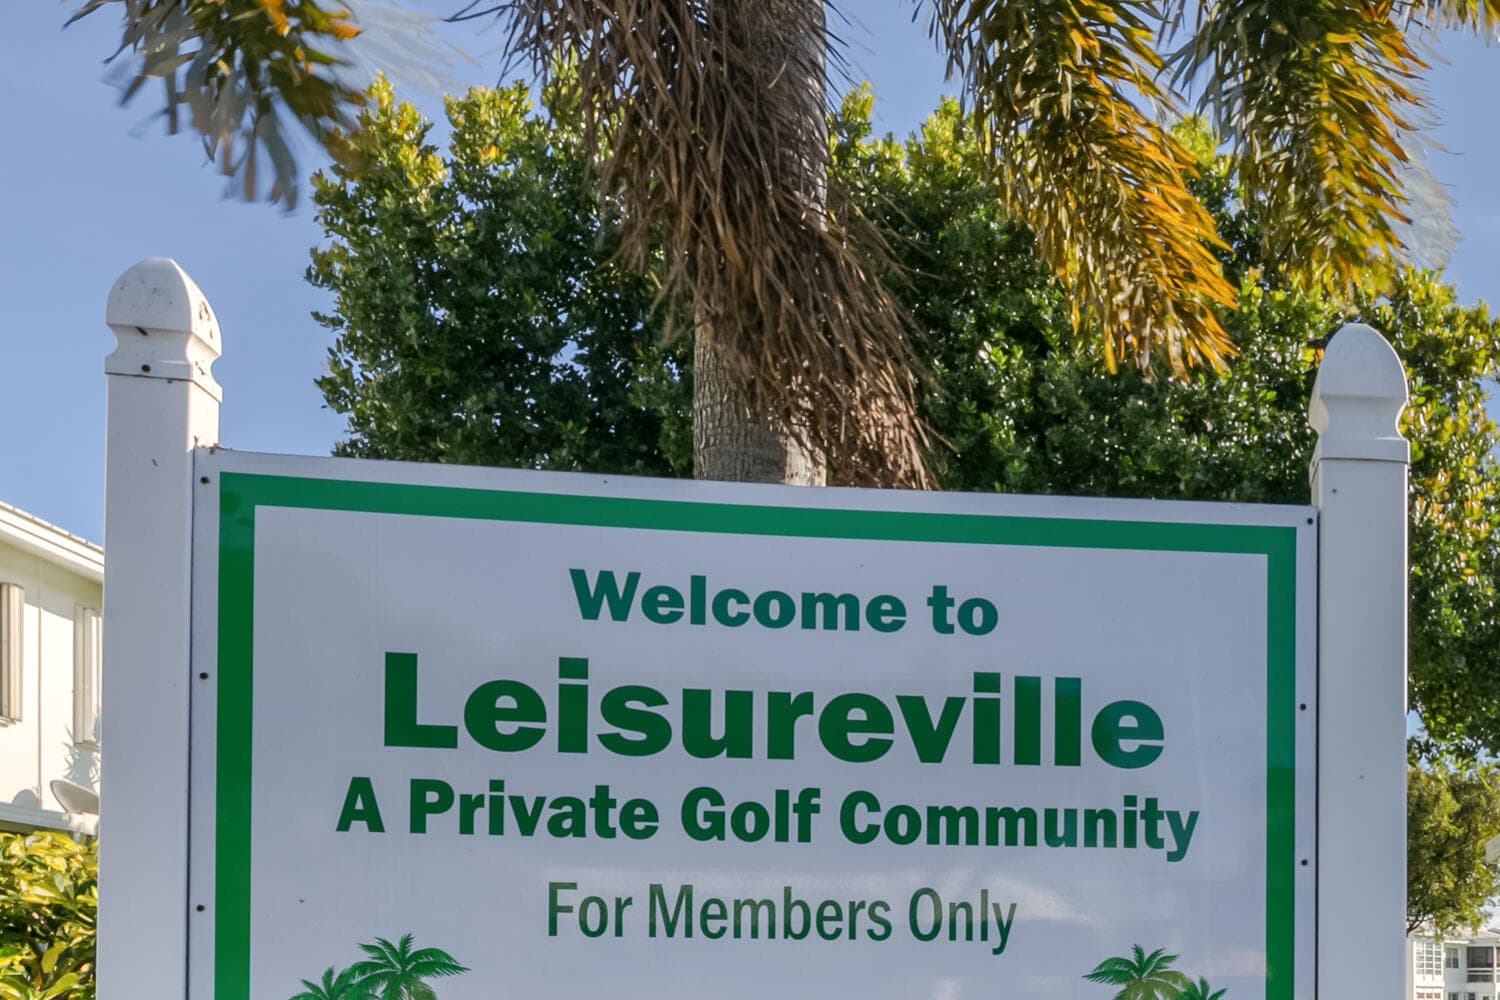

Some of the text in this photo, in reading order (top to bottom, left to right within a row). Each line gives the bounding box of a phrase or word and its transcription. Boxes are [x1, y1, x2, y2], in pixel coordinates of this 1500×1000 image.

[569, 568, 999, 637] Welcome to
[383, 651, 1165, 770] Leisureville
[335, 776, 1200, 863] A Private Golf Community
[547, 882, 1017, 956] For Members Only
